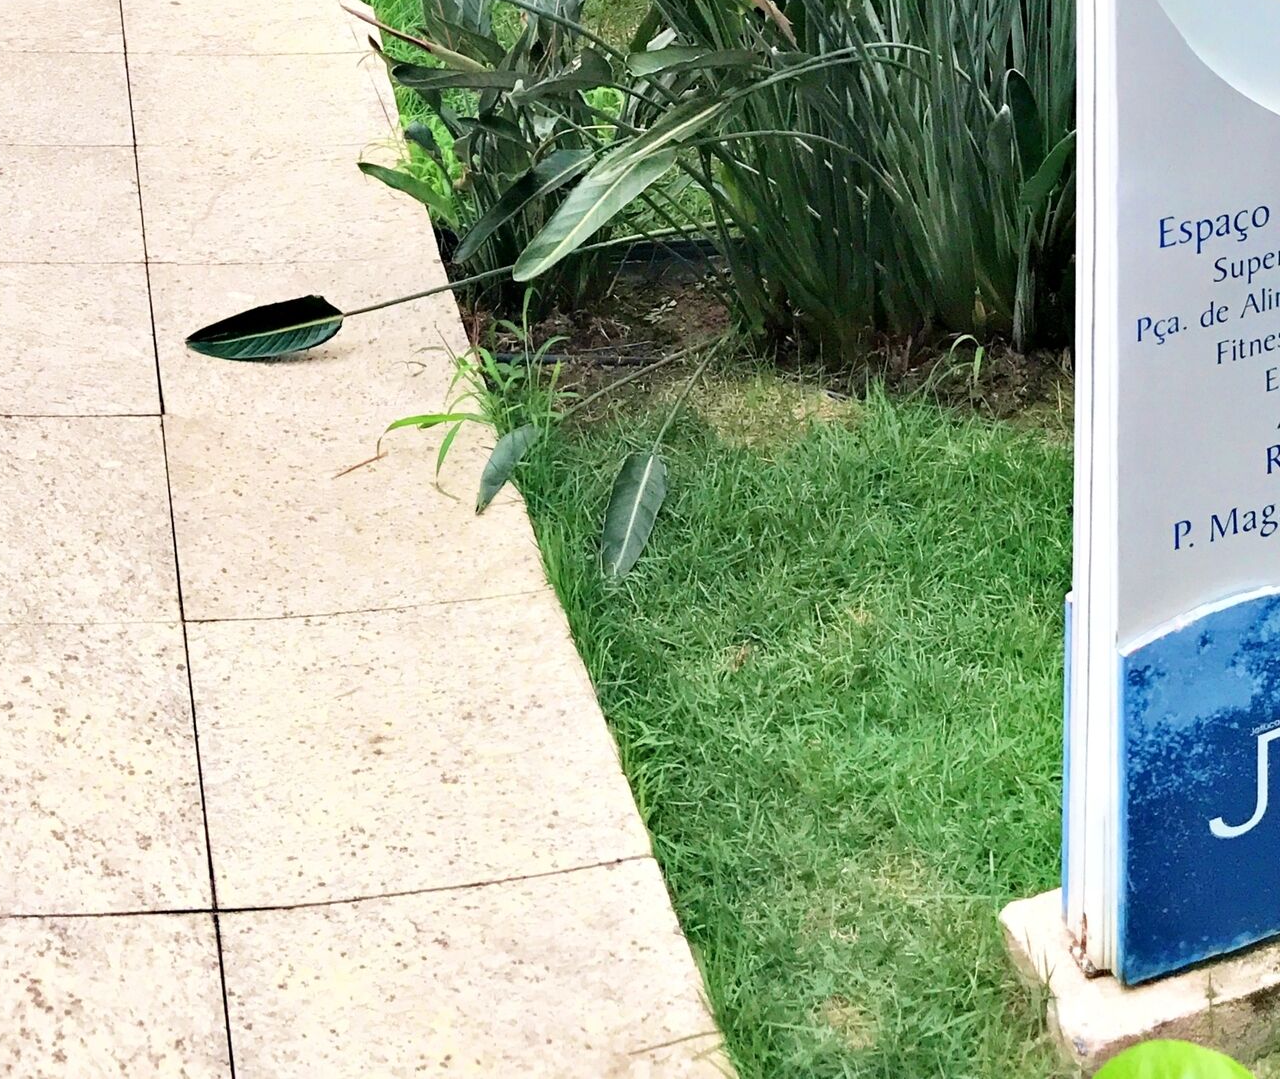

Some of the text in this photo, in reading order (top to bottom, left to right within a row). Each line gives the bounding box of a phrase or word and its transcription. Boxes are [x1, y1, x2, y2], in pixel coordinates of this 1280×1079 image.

[1159, 205, 1270, 255] Espaço
[1136, 316, 1188, 346] Pça.
[1199, 300, 1229, 328] de
[1174, 519, 1195, 551] P.
